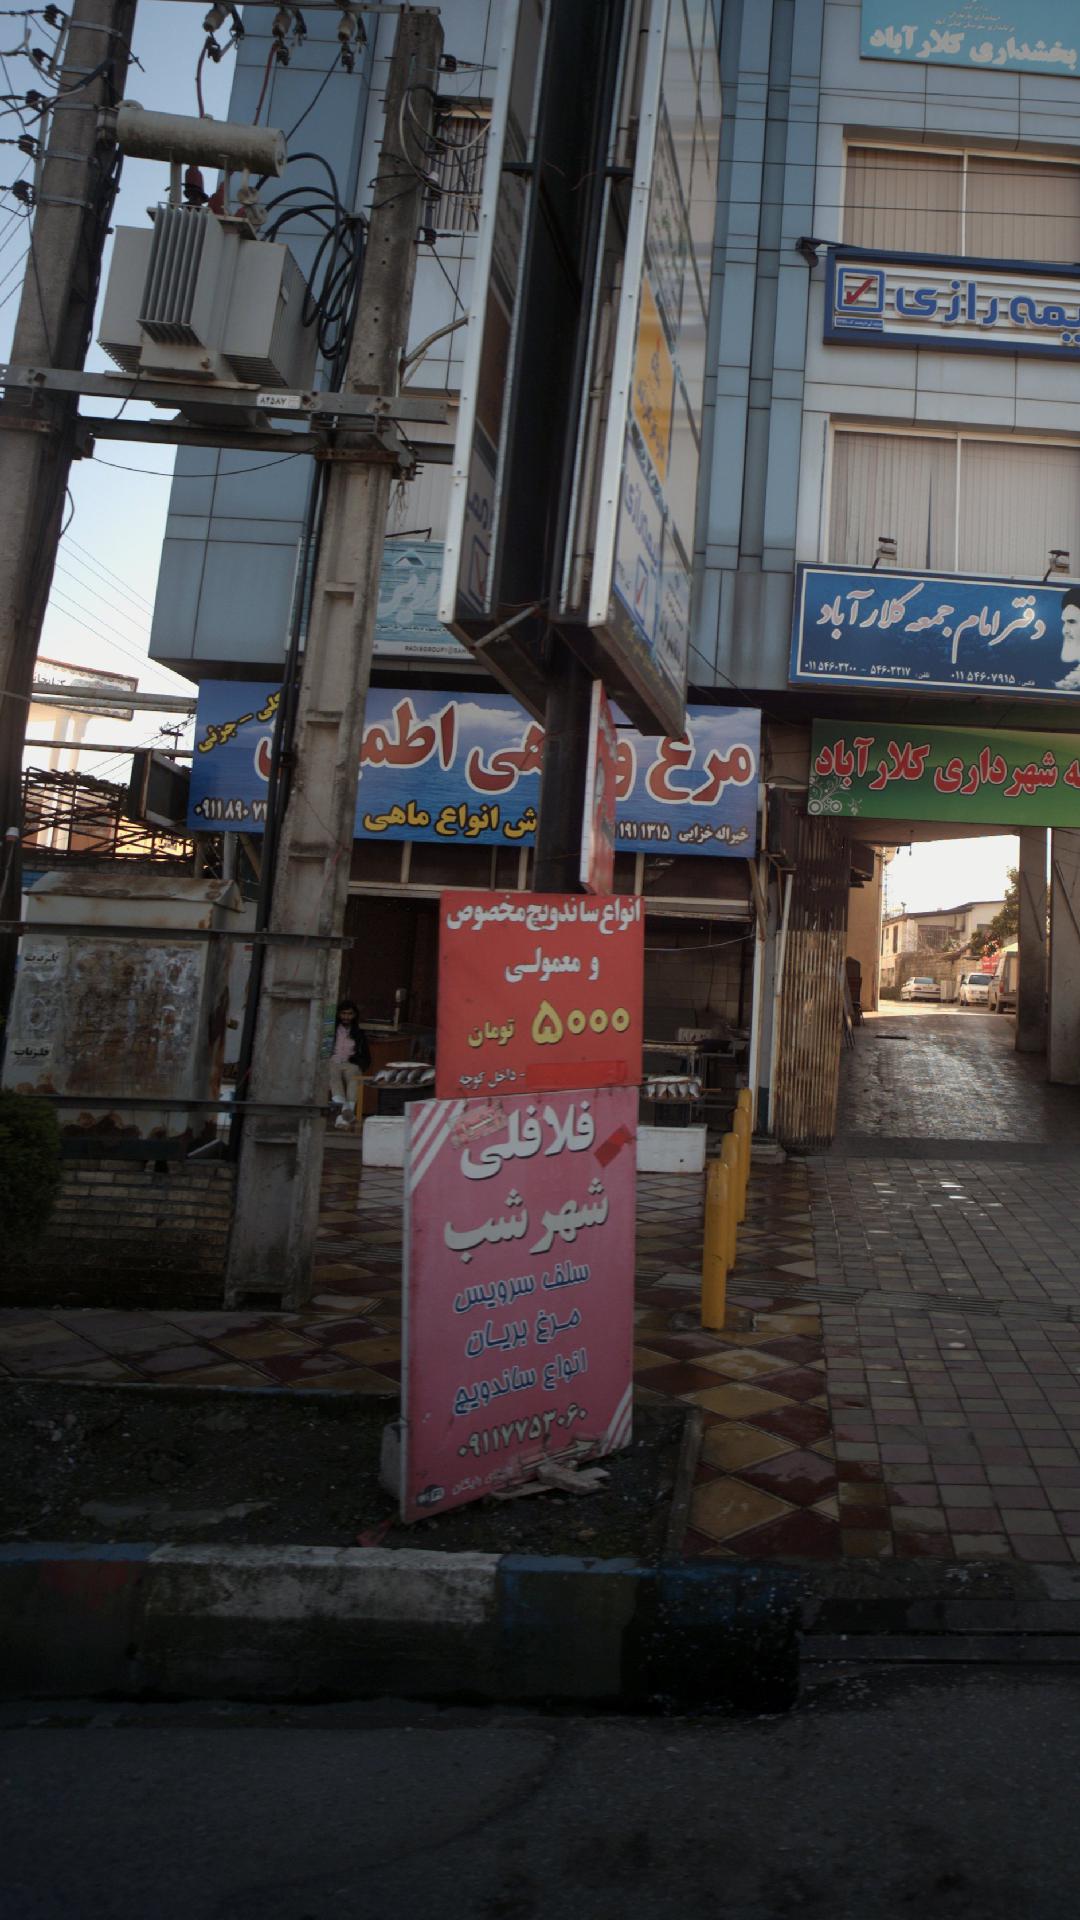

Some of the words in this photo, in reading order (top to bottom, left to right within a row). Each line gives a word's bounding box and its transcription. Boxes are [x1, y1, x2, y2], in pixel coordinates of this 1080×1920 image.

[969, 36, 1078, 71] بخشداری
[895, 280, 1000, 329] رازی
[1010, 294, 1080, 346] یمه
[816, 589, 875, 639] آباد
[904, 605, 954, 637] جمعه
[987, 595, 1046, 646] دفتر
[952, 606, 1001, 664] امام
[815, 737, 875, 787] آباد
[869, 741, 930, 790] کلار
[933, 746, 1058, 797] شهرداری
[362, 800, 430, 831] ماهی
[434, 801, 500, 837] انواع
[447, 894, 525, 930] مخصوص
[598, 897, 641, 934] انواع
[505, 947, 581, 983] معمولی
[588, 955, 599, 980] و
[468, 1018, 515, 1047] تومان
[461, 1100, 597, 1180] فلافلی
[444, 1188, 528, 1264] شب
[529, 1177, 609, 1254] شهر
[453, 1273, 535, 1313] سرویس
[541, 1260, 590, 1290] سلف
[465, 1320, 527, 1358] بریان
[534, 1307, 581, 1343] مرغ
[543, 1348, 588, 1392] انواع
